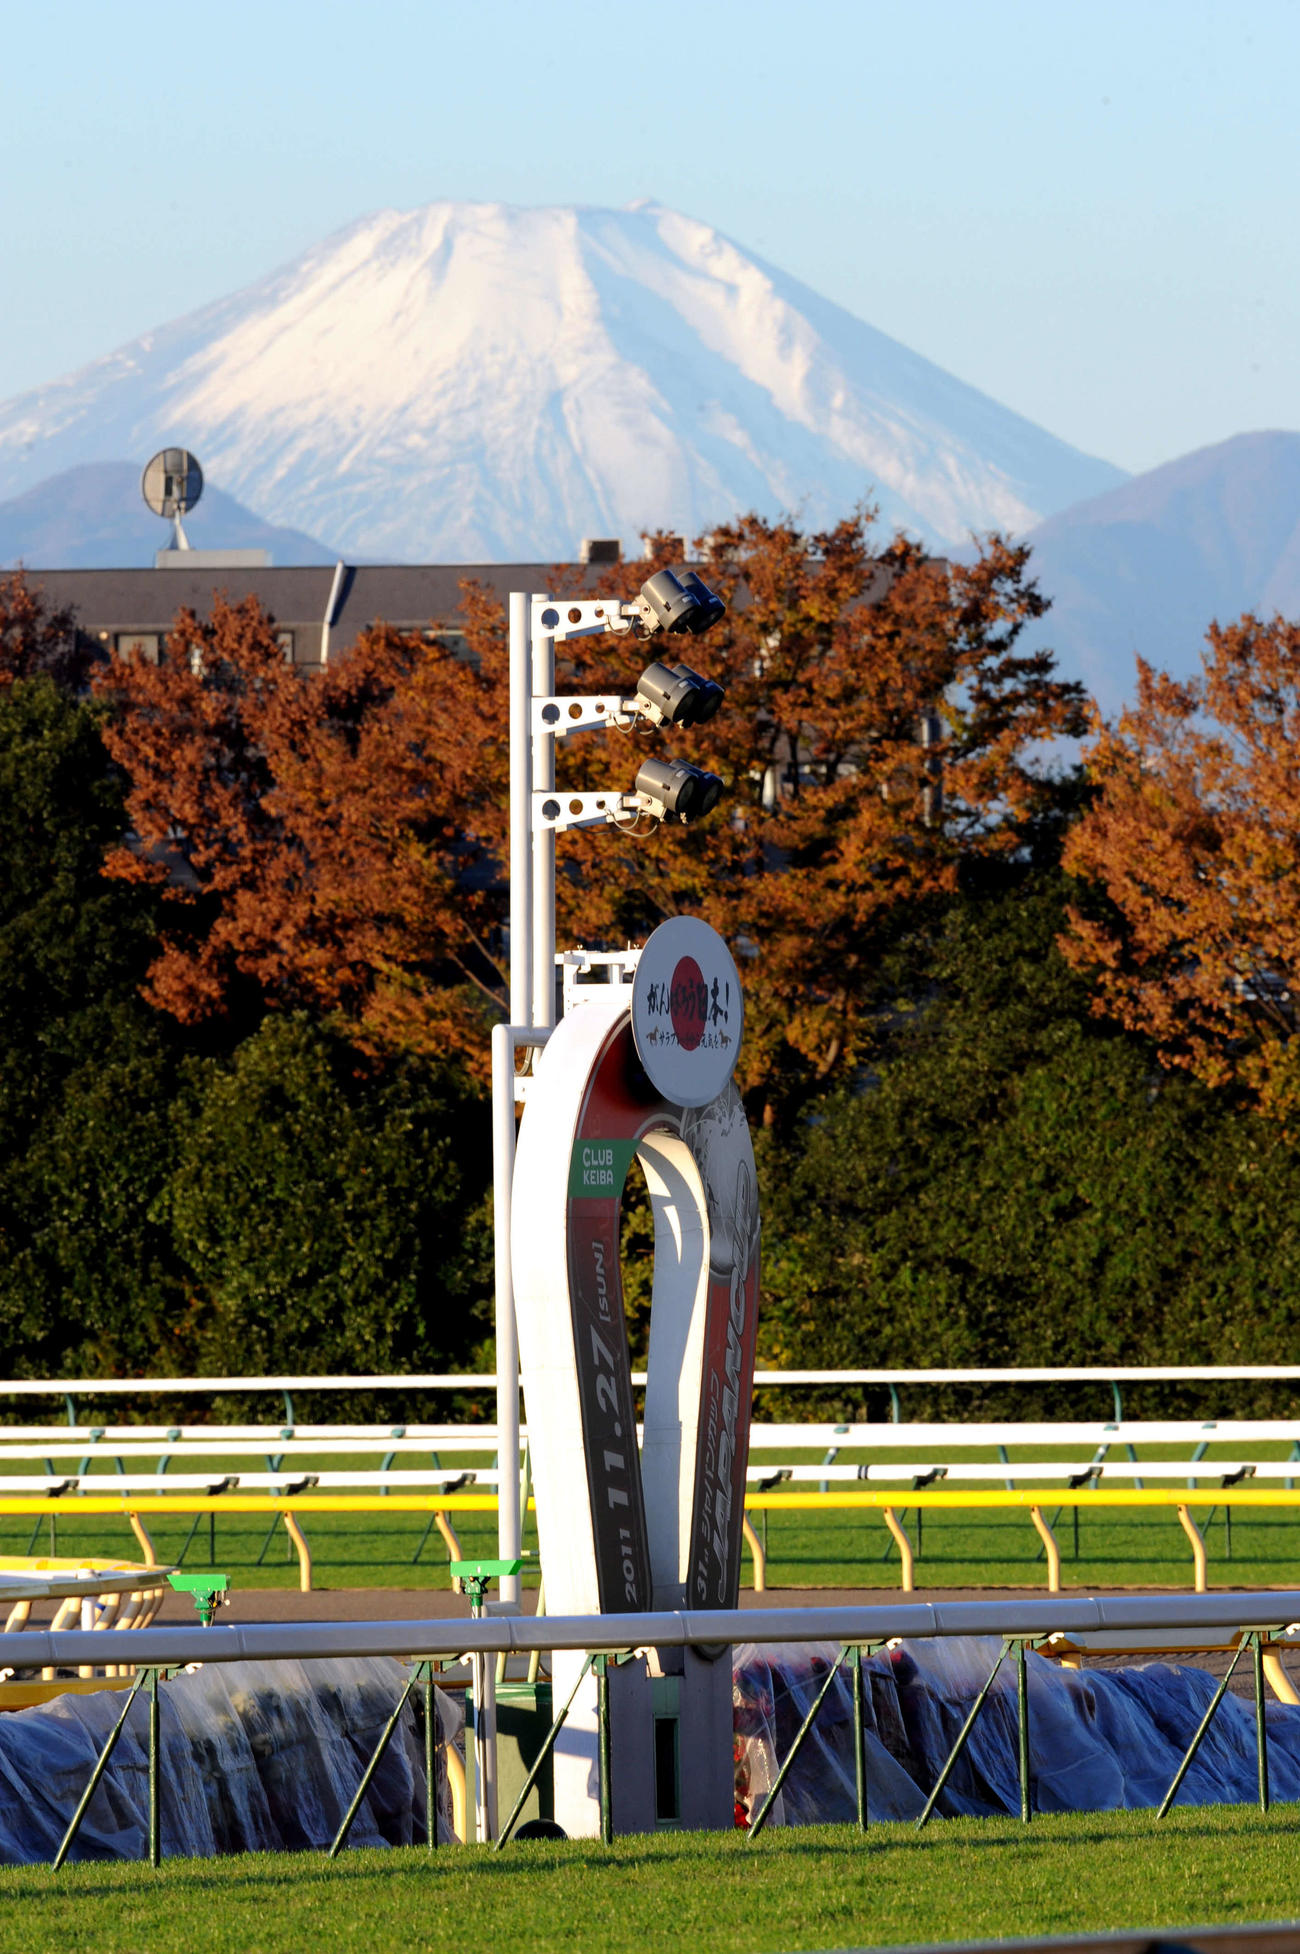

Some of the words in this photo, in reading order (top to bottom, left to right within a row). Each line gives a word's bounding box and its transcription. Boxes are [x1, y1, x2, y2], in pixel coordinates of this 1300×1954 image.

[582, 1147, 613, 1167] CLUB
[583, 1169, 614, 1185] KEIBA
[592, 1241, 611, 1322] [SUN]
[713, 1320, 743, 1604] JAPAN
[730, 1160, 751, 1336] CUP
[619, 1527, 637, 1604] 2011
